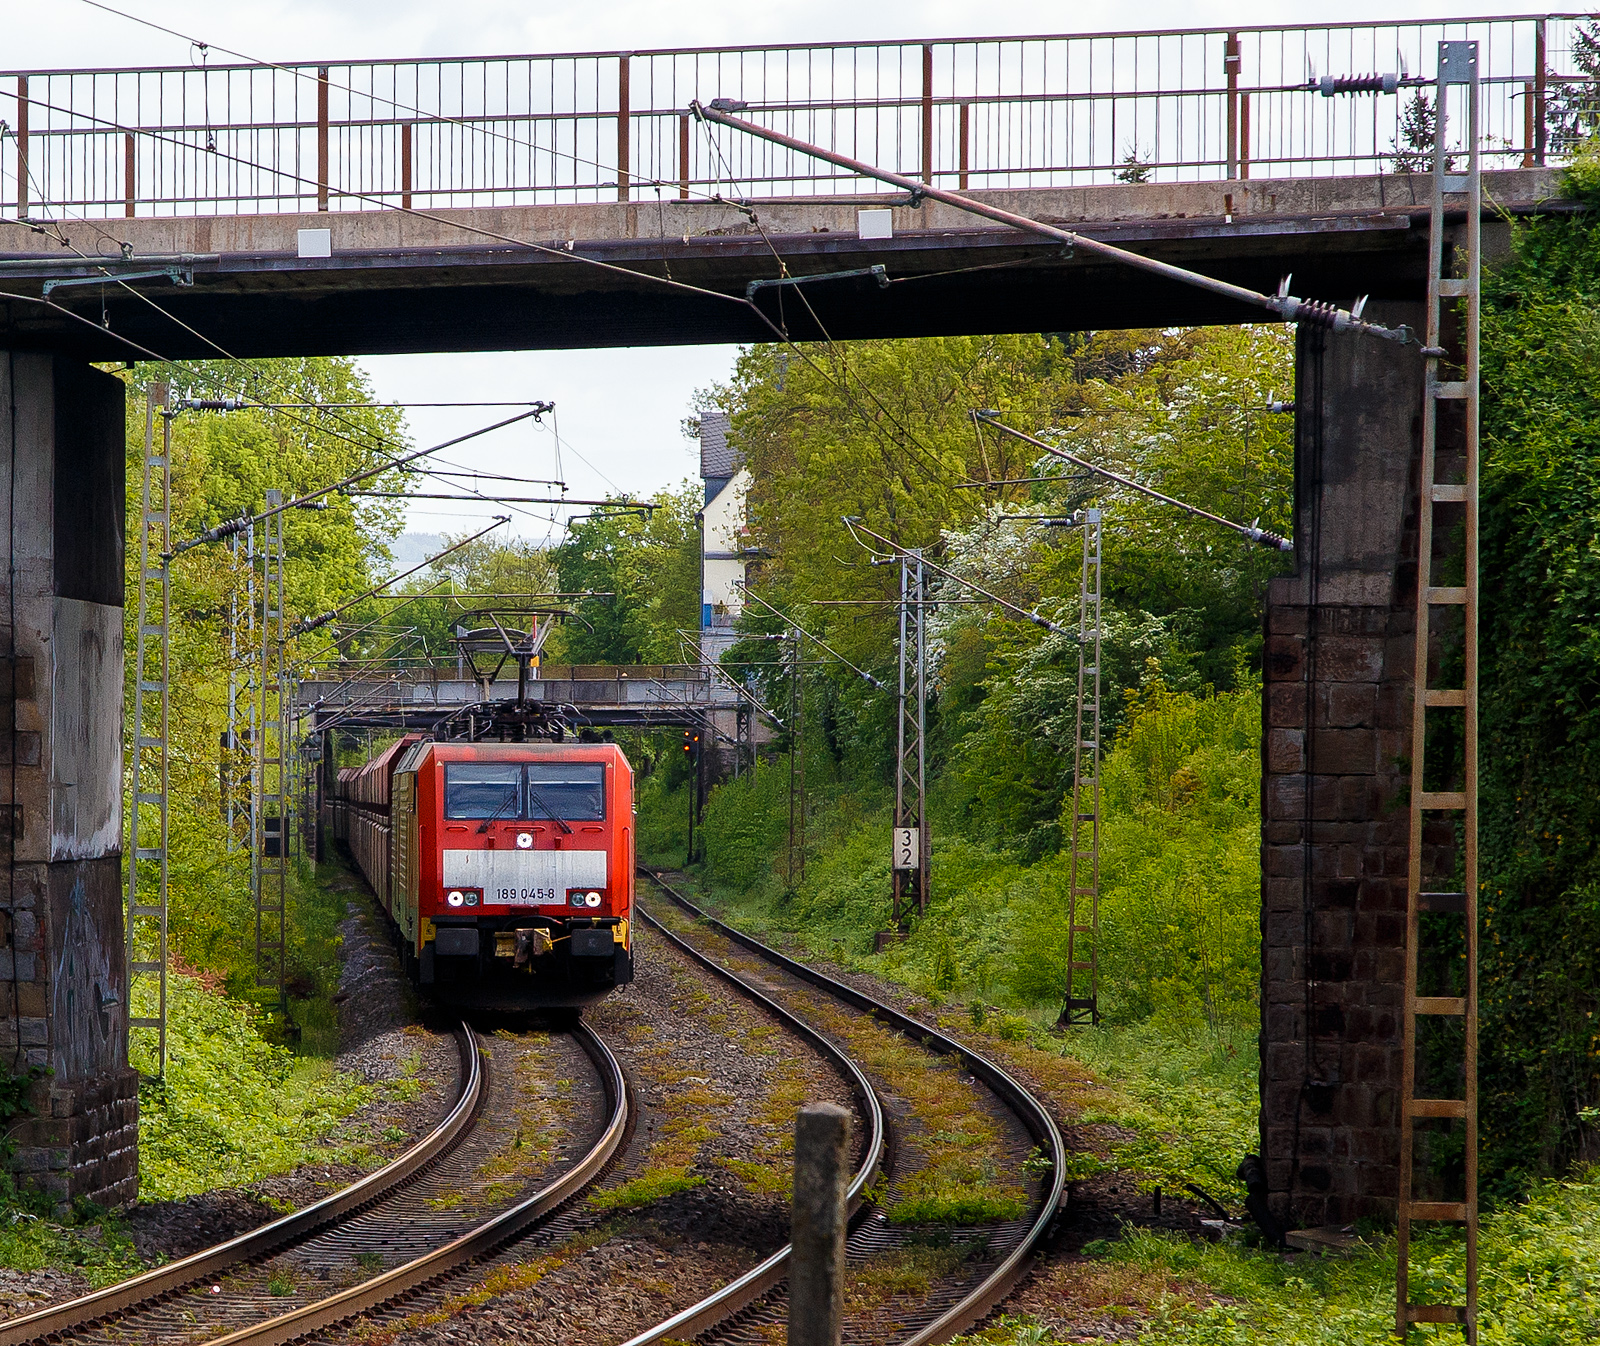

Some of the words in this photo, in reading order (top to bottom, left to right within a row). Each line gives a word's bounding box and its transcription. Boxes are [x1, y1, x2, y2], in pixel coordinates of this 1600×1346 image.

[902, 830, 911, 847] 3
[902, 848, 911, 865] 2
[497, 888, 517, 899] 189
[521, 888, 555, 899] 045-8
